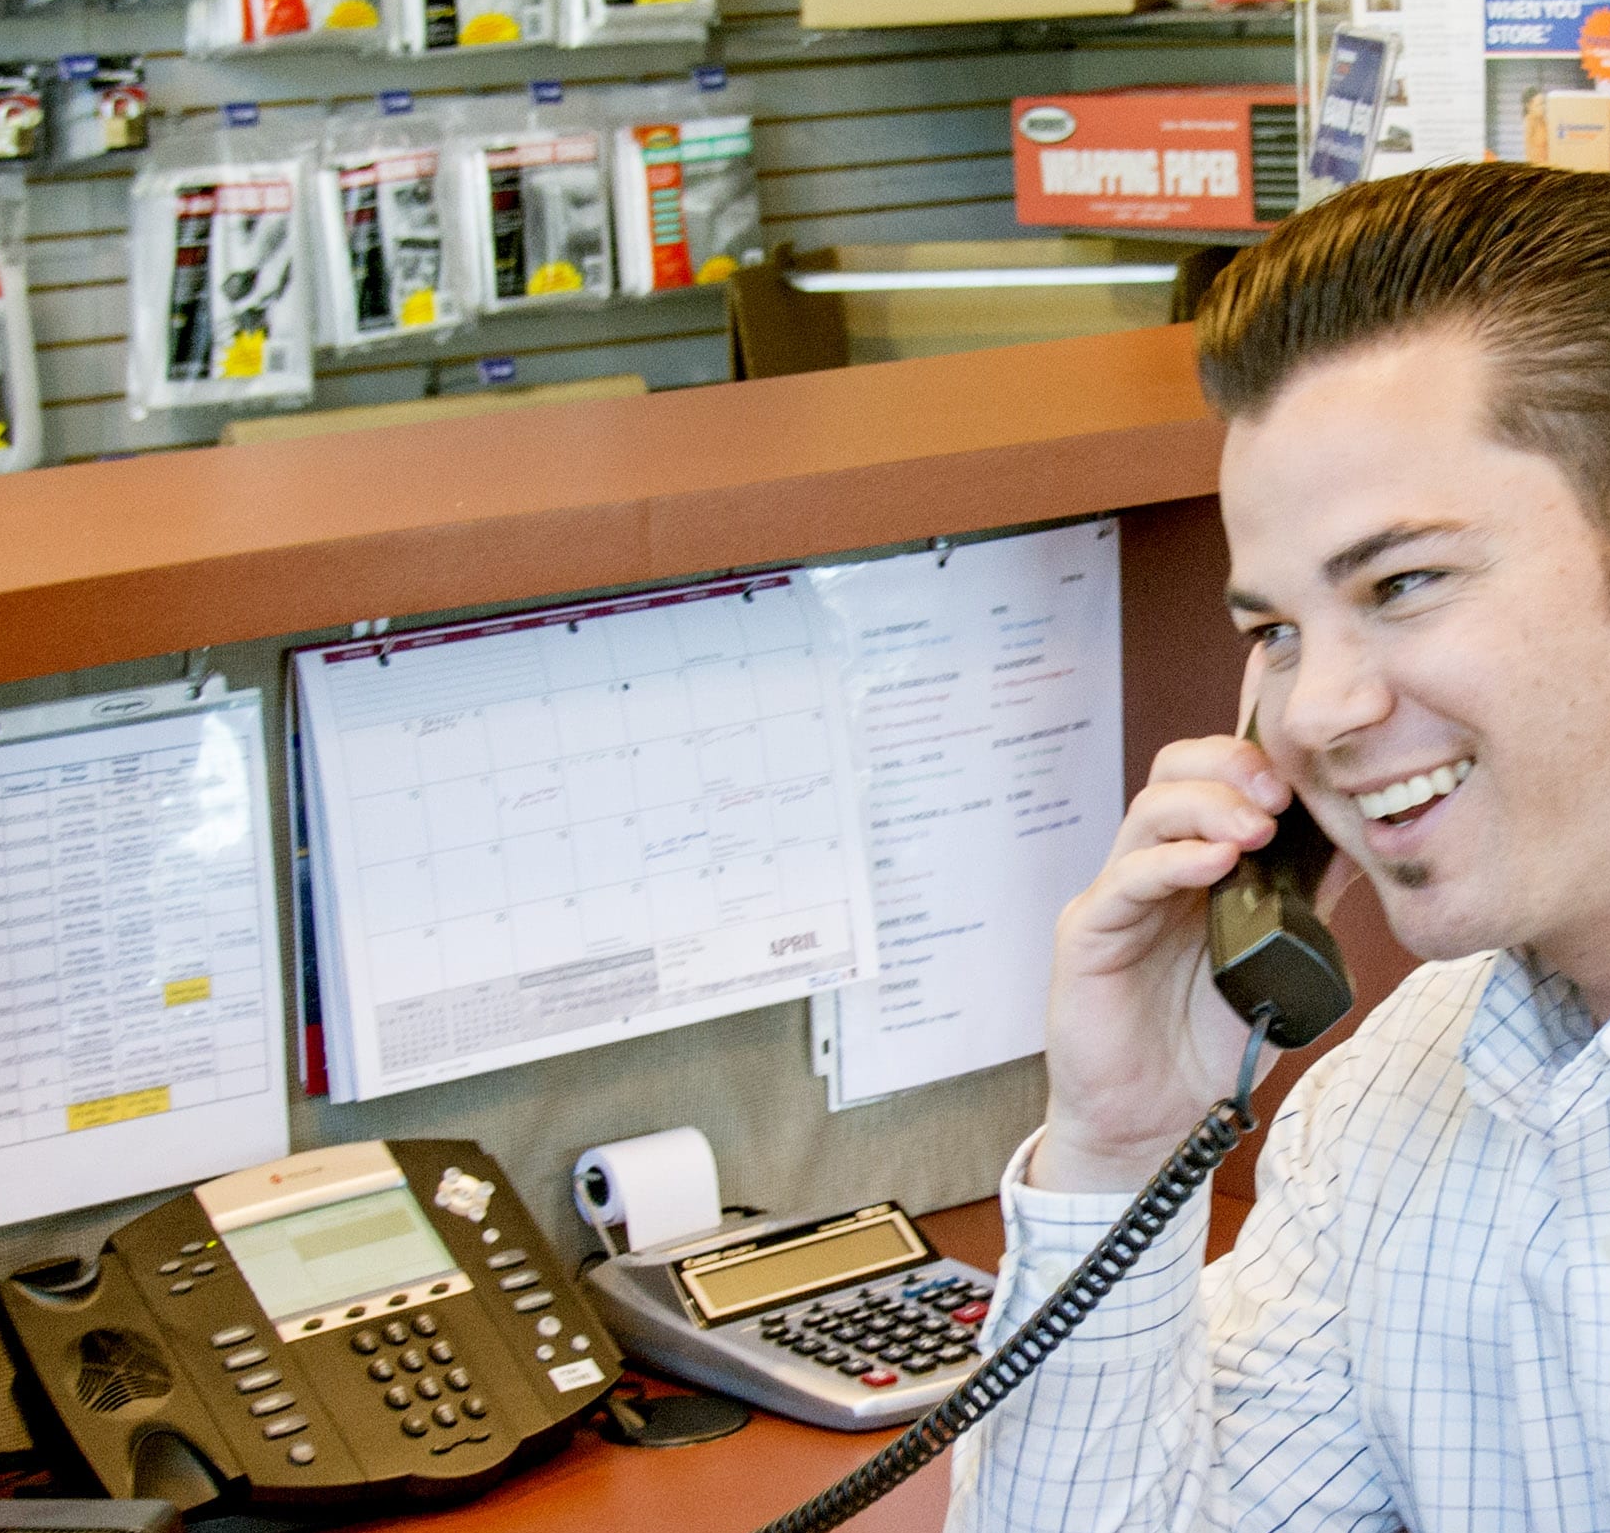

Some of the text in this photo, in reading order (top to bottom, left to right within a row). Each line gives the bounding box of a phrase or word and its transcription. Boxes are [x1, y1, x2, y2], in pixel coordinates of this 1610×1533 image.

[1487, 0, 1583, 20] WHEN YOU
[1038, 148, 1240, 196] WRAPPING PAPER
[768, 930, 823, 957] APRIL
